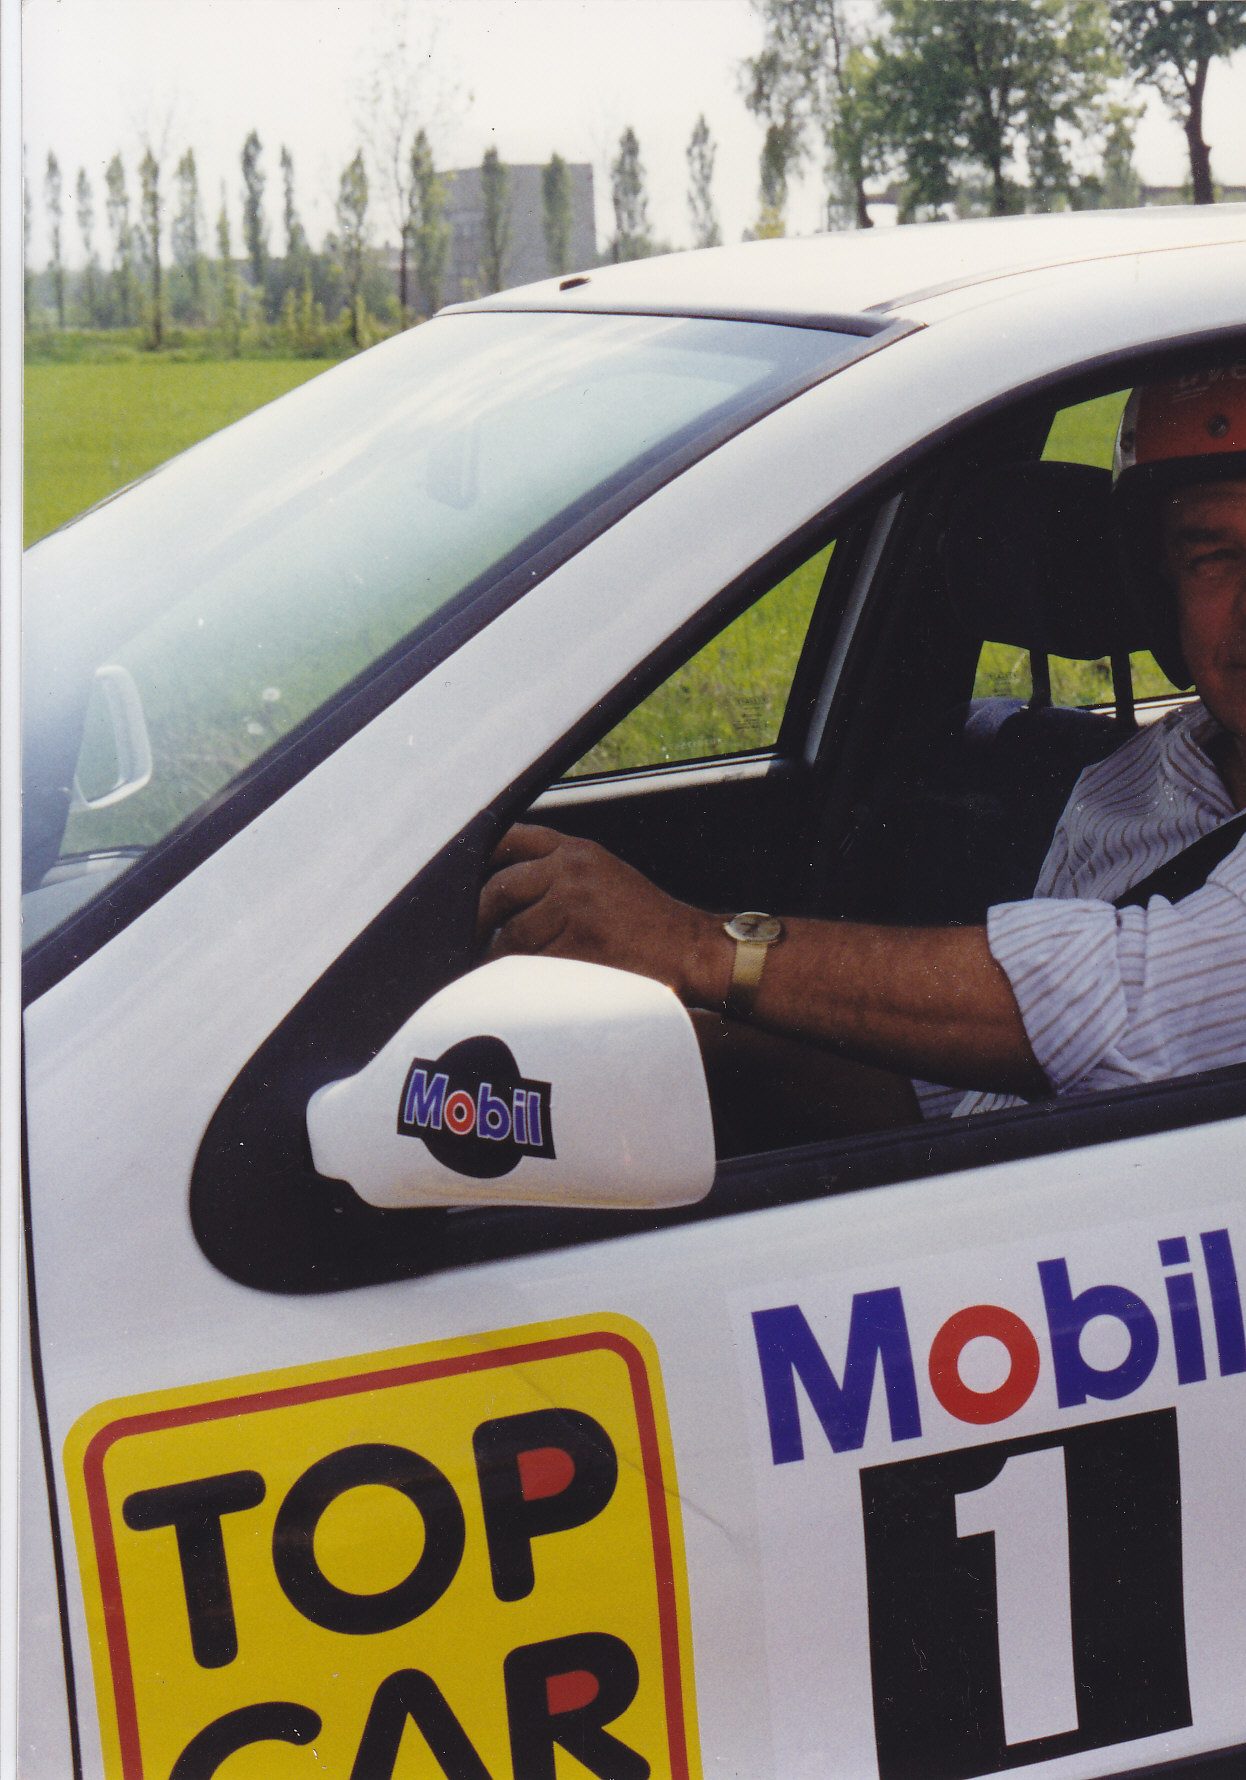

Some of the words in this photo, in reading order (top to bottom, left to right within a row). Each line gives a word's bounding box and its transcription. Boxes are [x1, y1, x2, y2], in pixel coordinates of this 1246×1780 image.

[404, 1069, 544, 1147] Mobil
[122, 1407, 618, 1669] TOP
[954, 1445, 1079, 1747] 1
